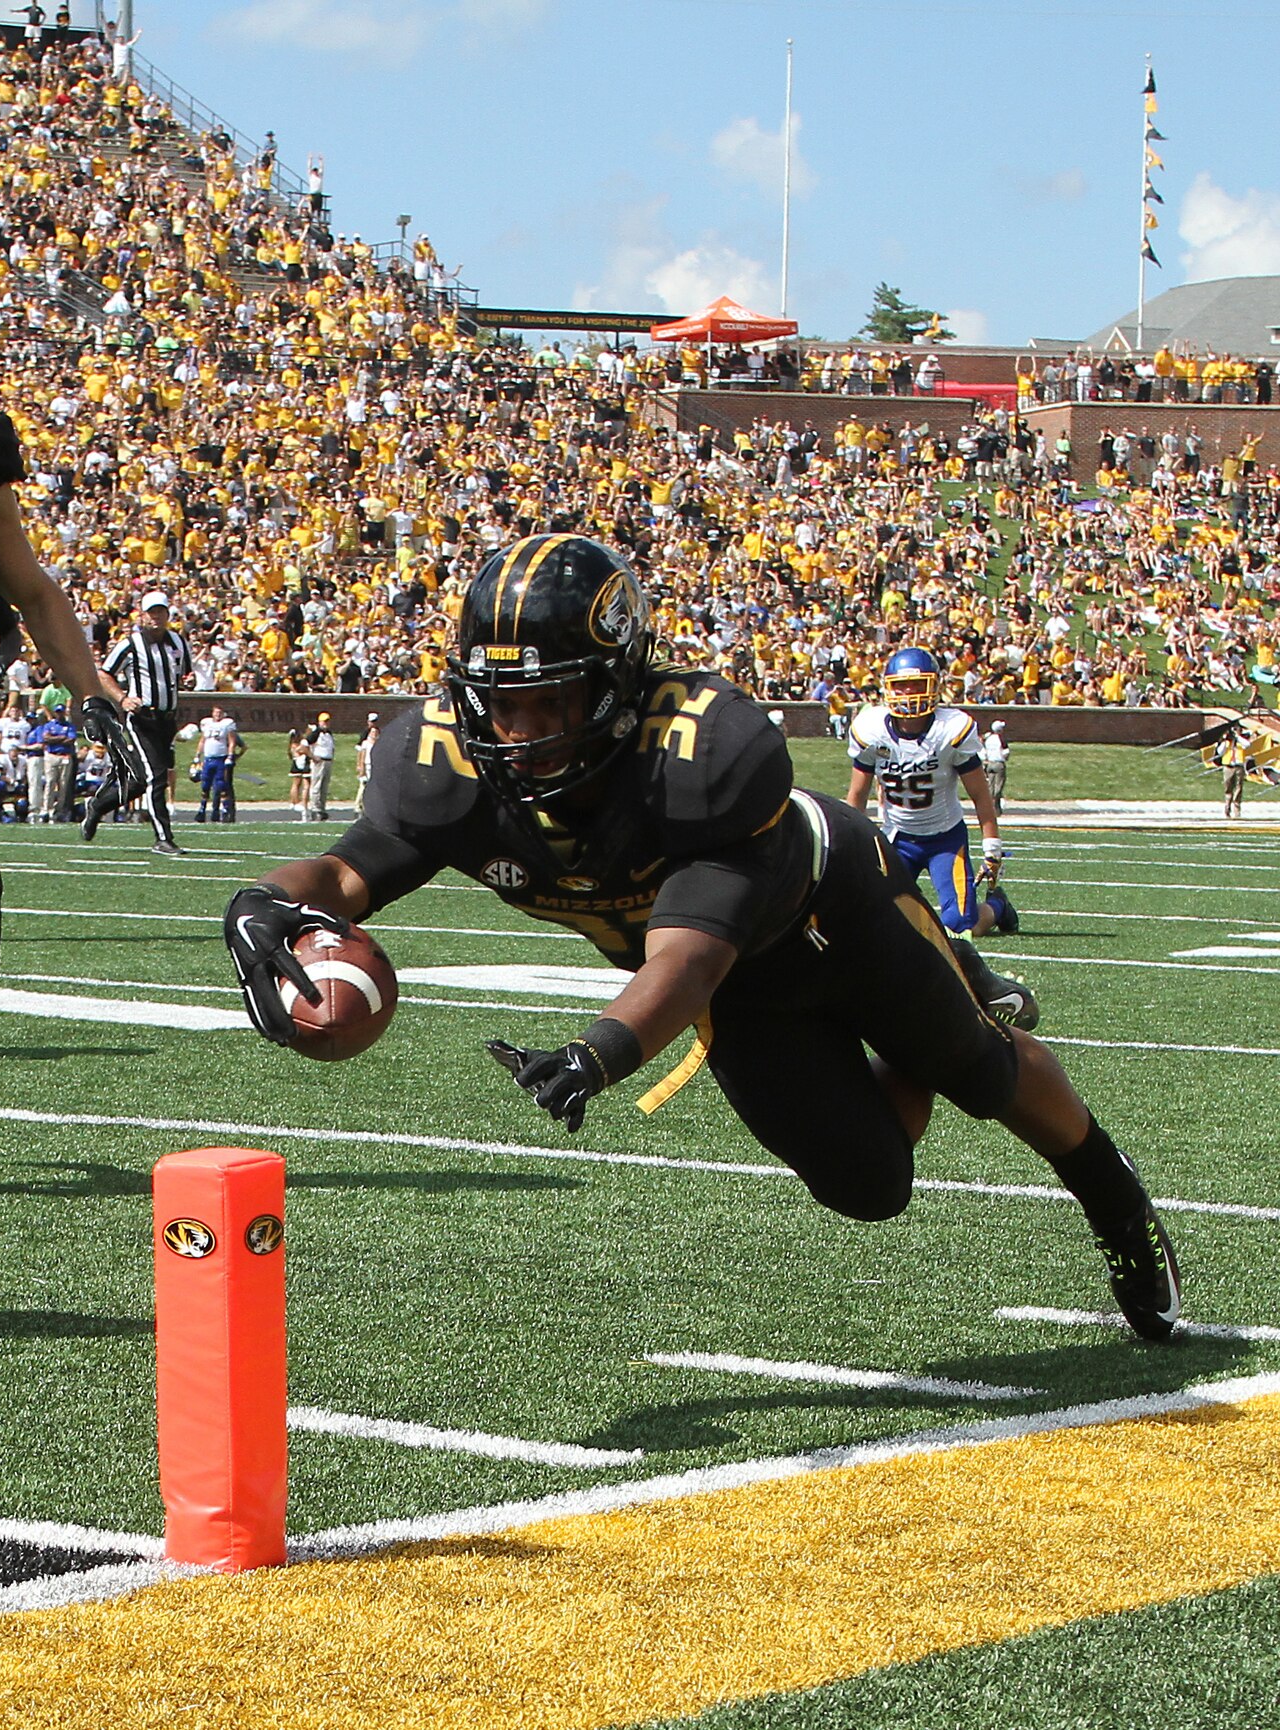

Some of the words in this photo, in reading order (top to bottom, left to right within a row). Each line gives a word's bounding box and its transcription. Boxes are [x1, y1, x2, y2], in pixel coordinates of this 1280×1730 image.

[486, 647, 521, 661] TIGERS
[880, 759, 939, 774] JACKS
[882, 772, 934, 810] 25
[484, 861, 524, 888] SEC
